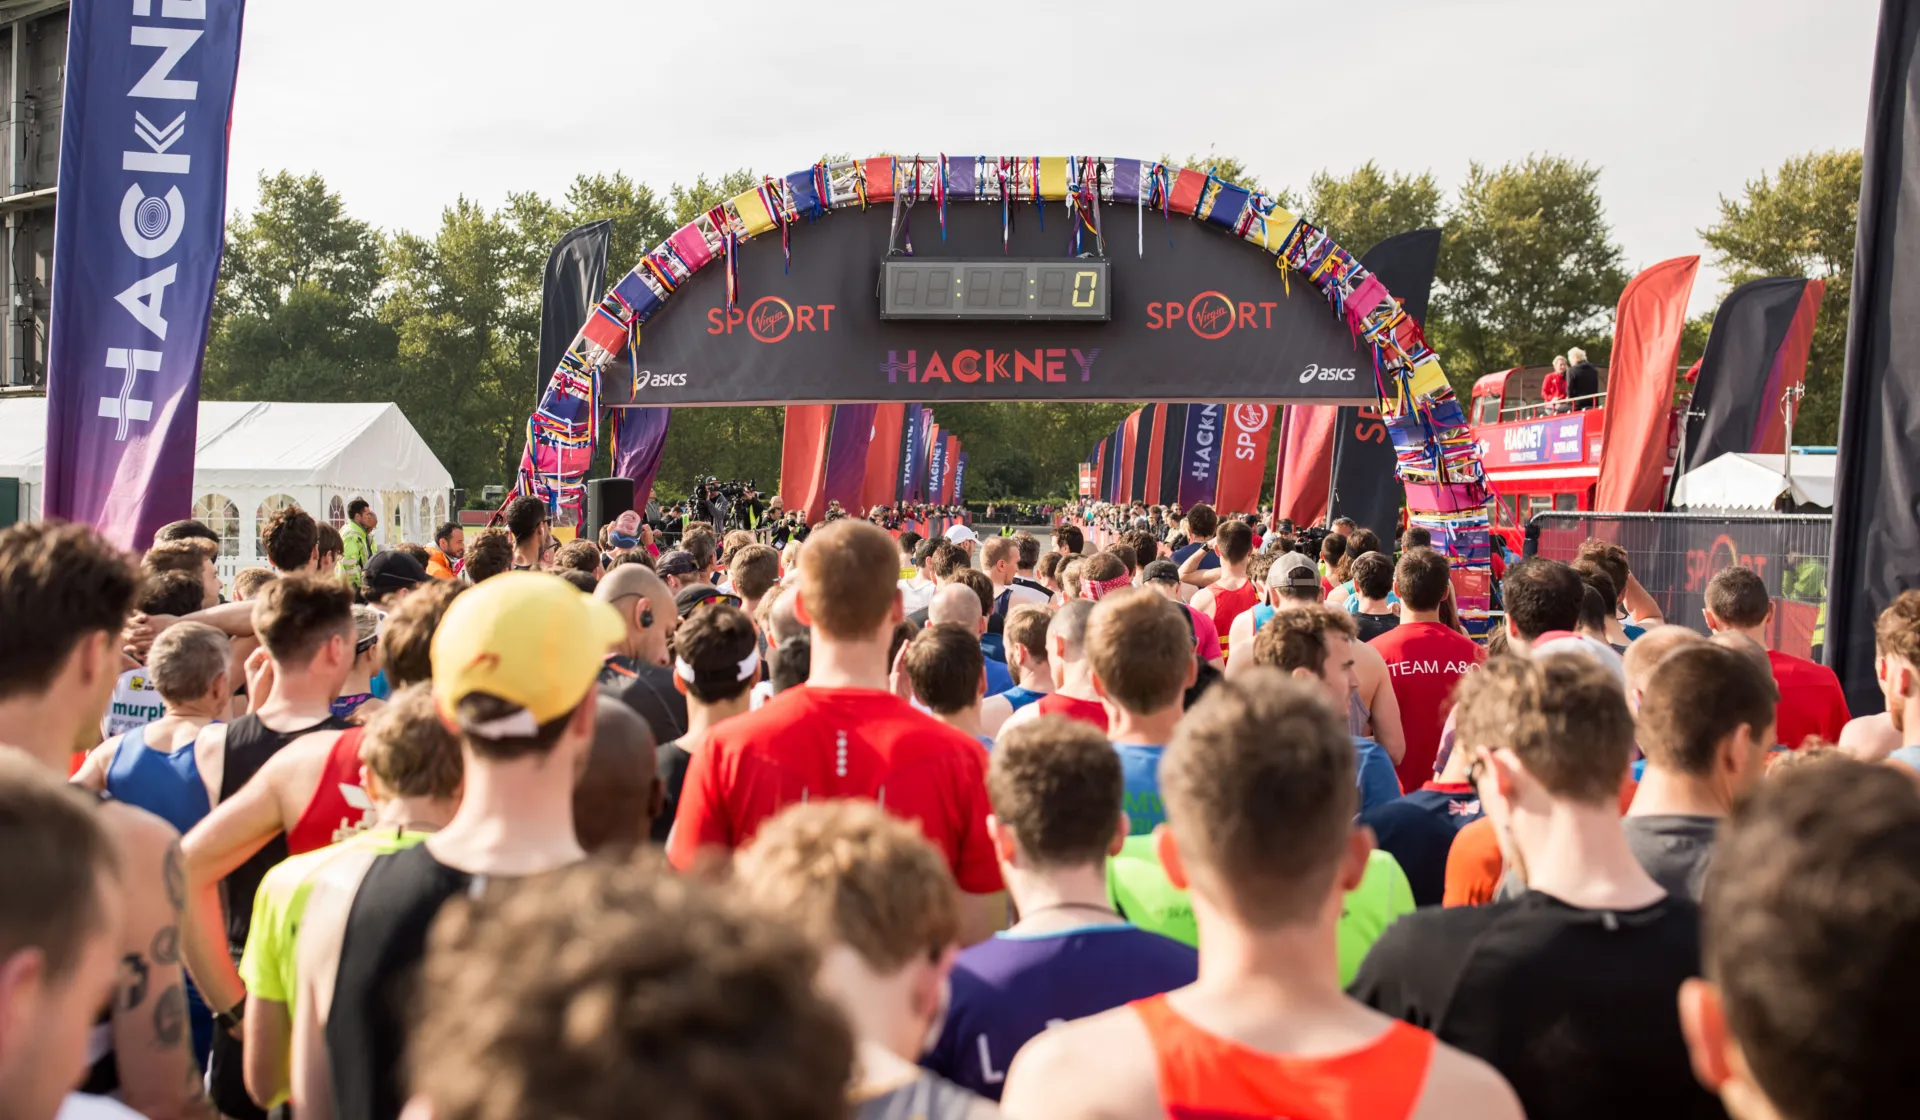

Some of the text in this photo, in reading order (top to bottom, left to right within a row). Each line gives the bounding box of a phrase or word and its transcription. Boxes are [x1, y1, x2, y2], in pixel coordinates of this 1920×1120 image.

[707, 296, 836, 343] SPORT
[755, 305, 786, 334] Virgin
[1146, 291, 1278, 339] SPORT
[1196, 301, 1228, 330] Virgin
[879, 348, 1100, 384] HACKNEY
[1388, 660, 1439, 677] TEAM
